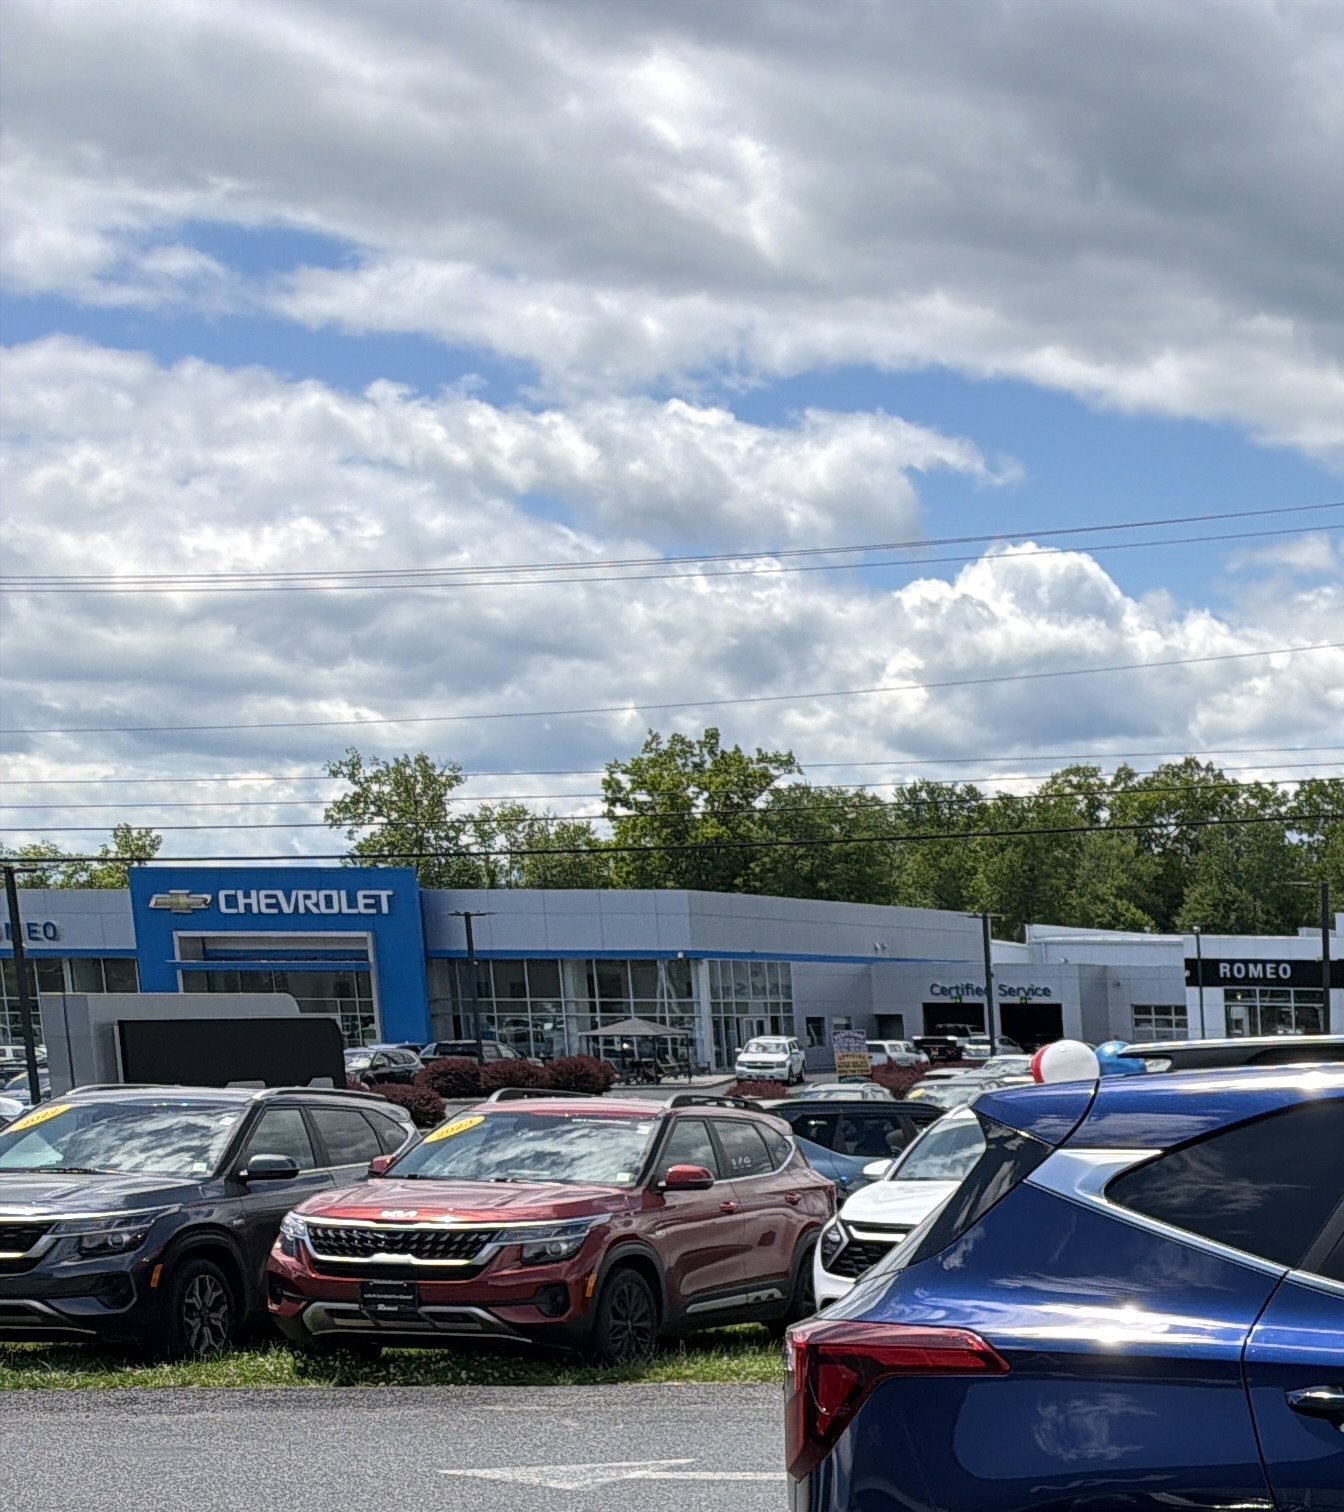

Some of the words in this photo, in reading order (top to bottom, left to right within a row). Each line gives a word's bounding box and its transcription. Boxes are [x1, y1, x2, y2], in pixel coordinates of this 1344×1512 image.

[218, 889, 394, 914] CHEVROLET
[1218, 962, 1292, 979] ROMEO
[997, 983, 1052, 997] Service
